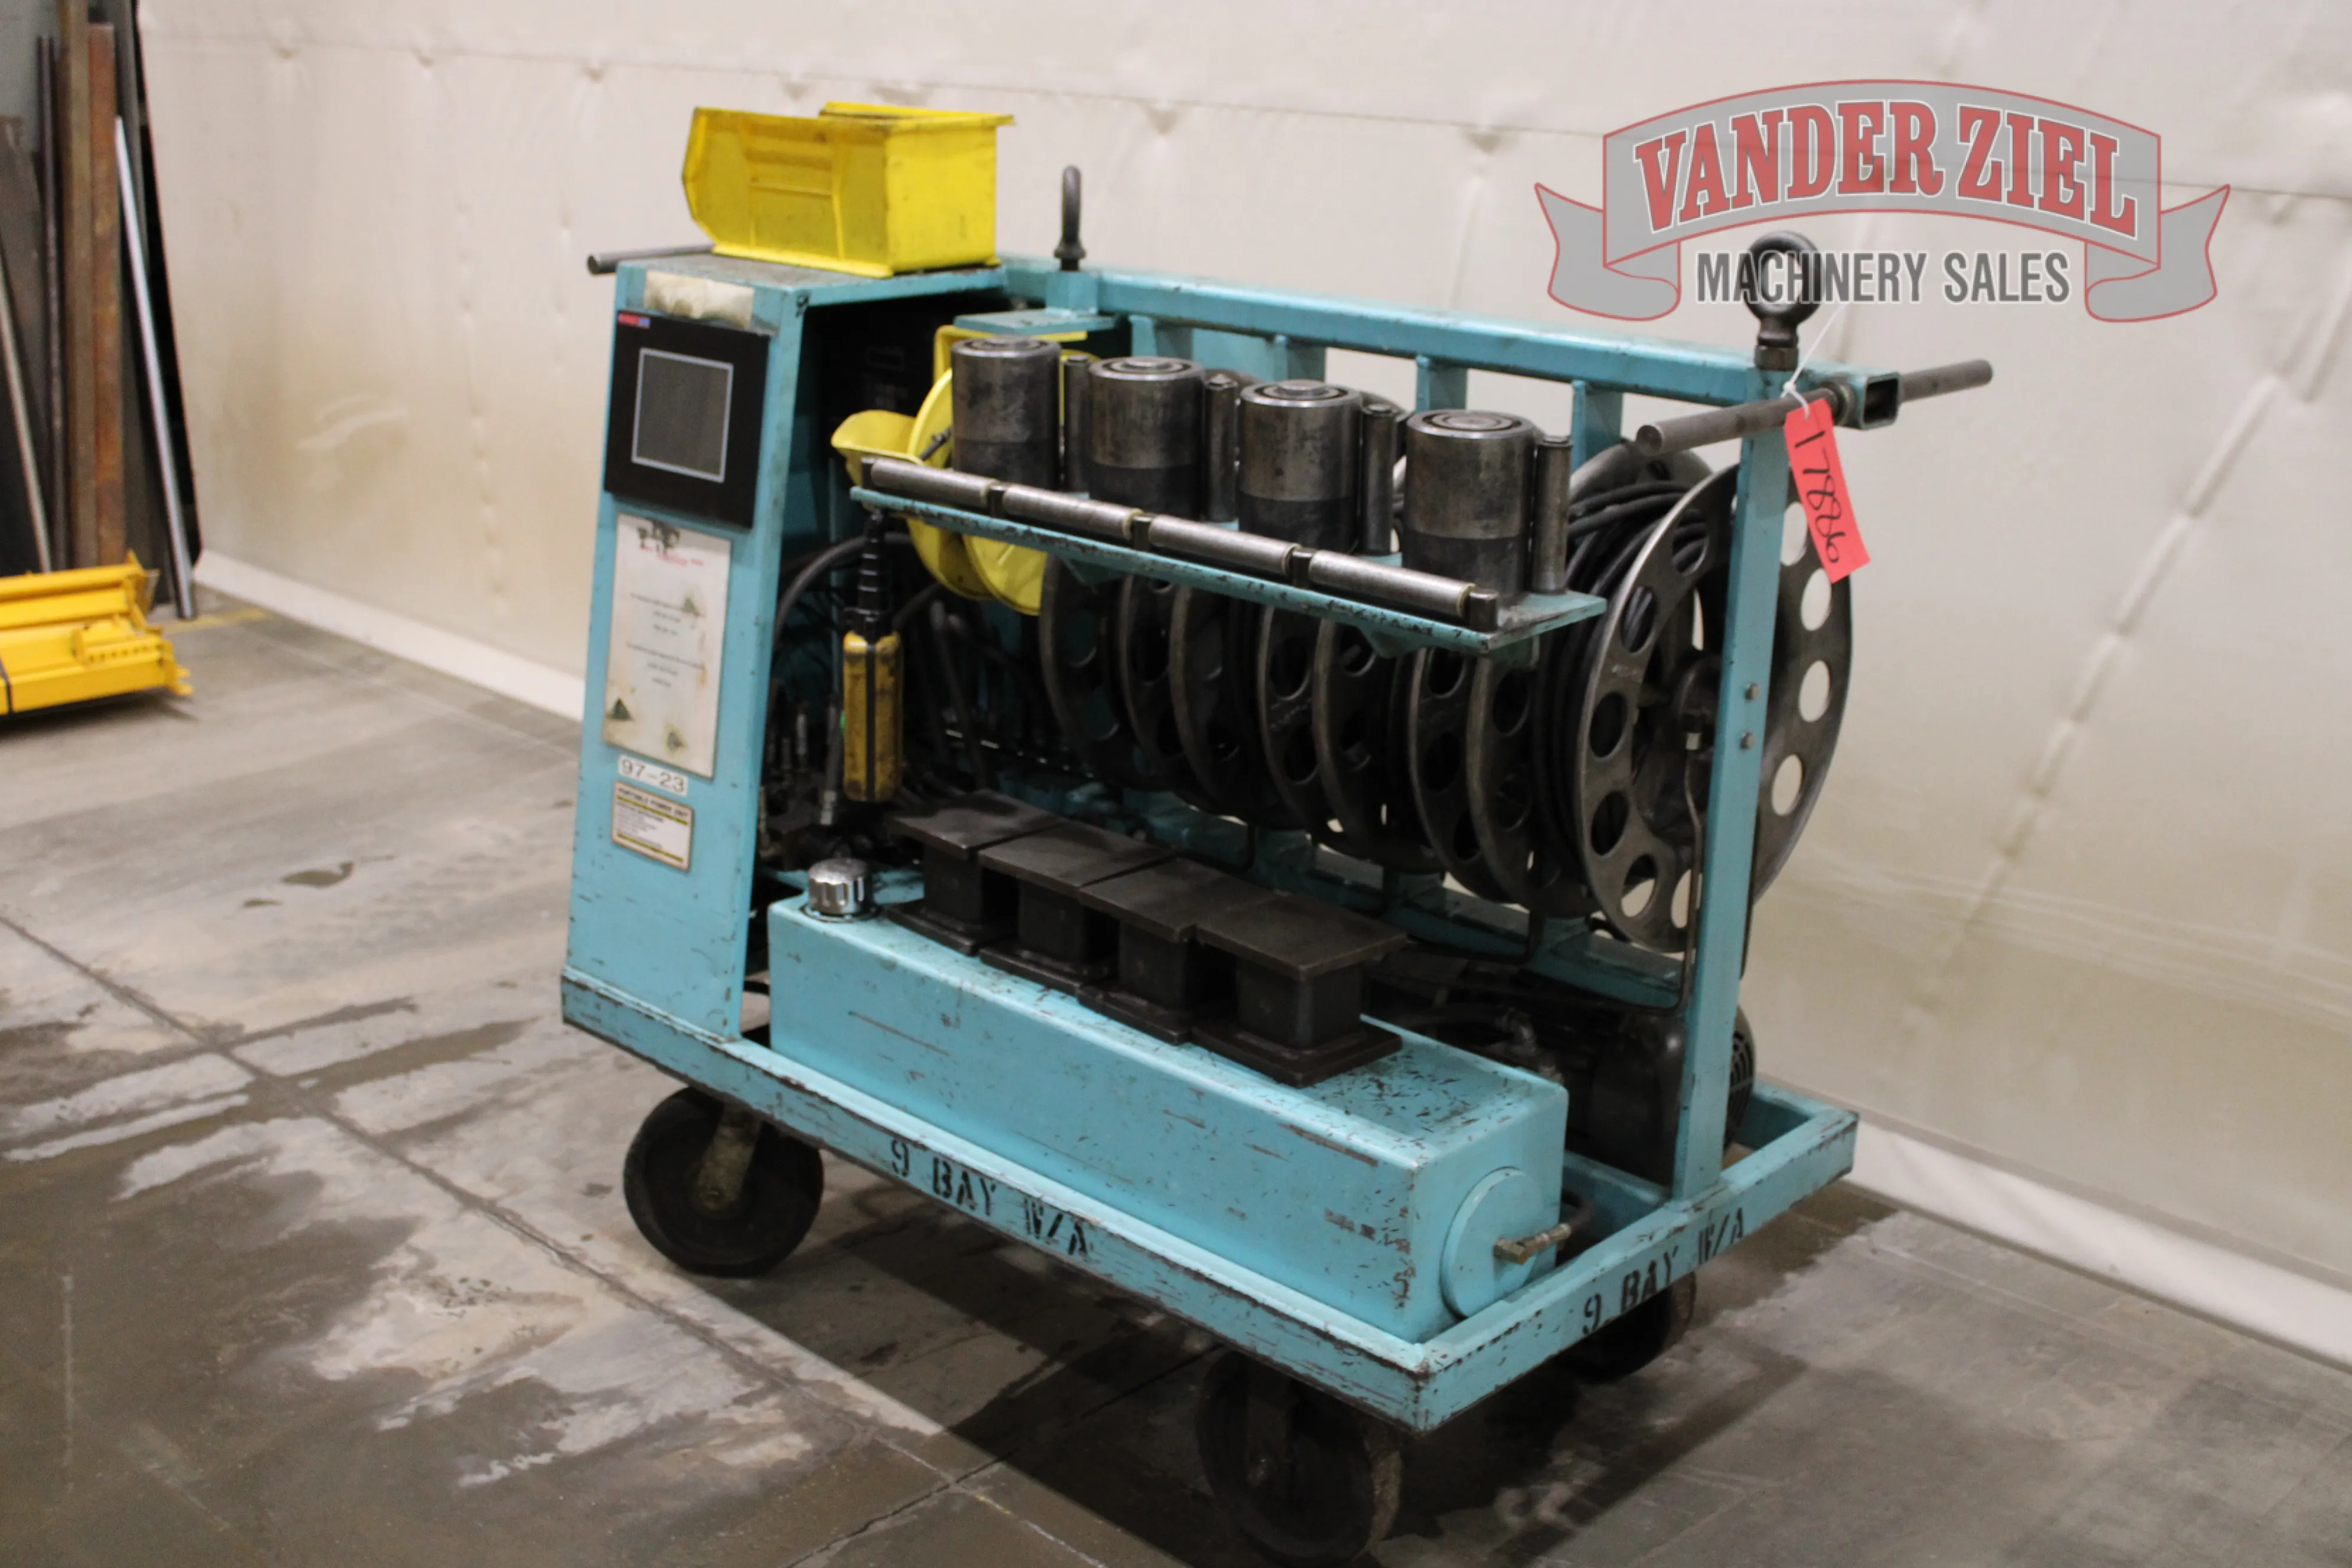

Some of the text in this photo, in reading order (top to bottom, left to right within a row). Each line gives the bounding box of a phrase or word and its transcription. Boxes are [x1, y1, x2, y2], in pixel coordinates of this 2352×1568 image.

[1795, 430, 1845, 564] 17886
[621, 758, 685, 793] 97-23
[891, 1139, 910, 1177] 9
[933, 1156, 997, 1217] BAY
[1582, 1293, 1602, 1335] 9
[1621, 1245, 1679, 1317] BAY
